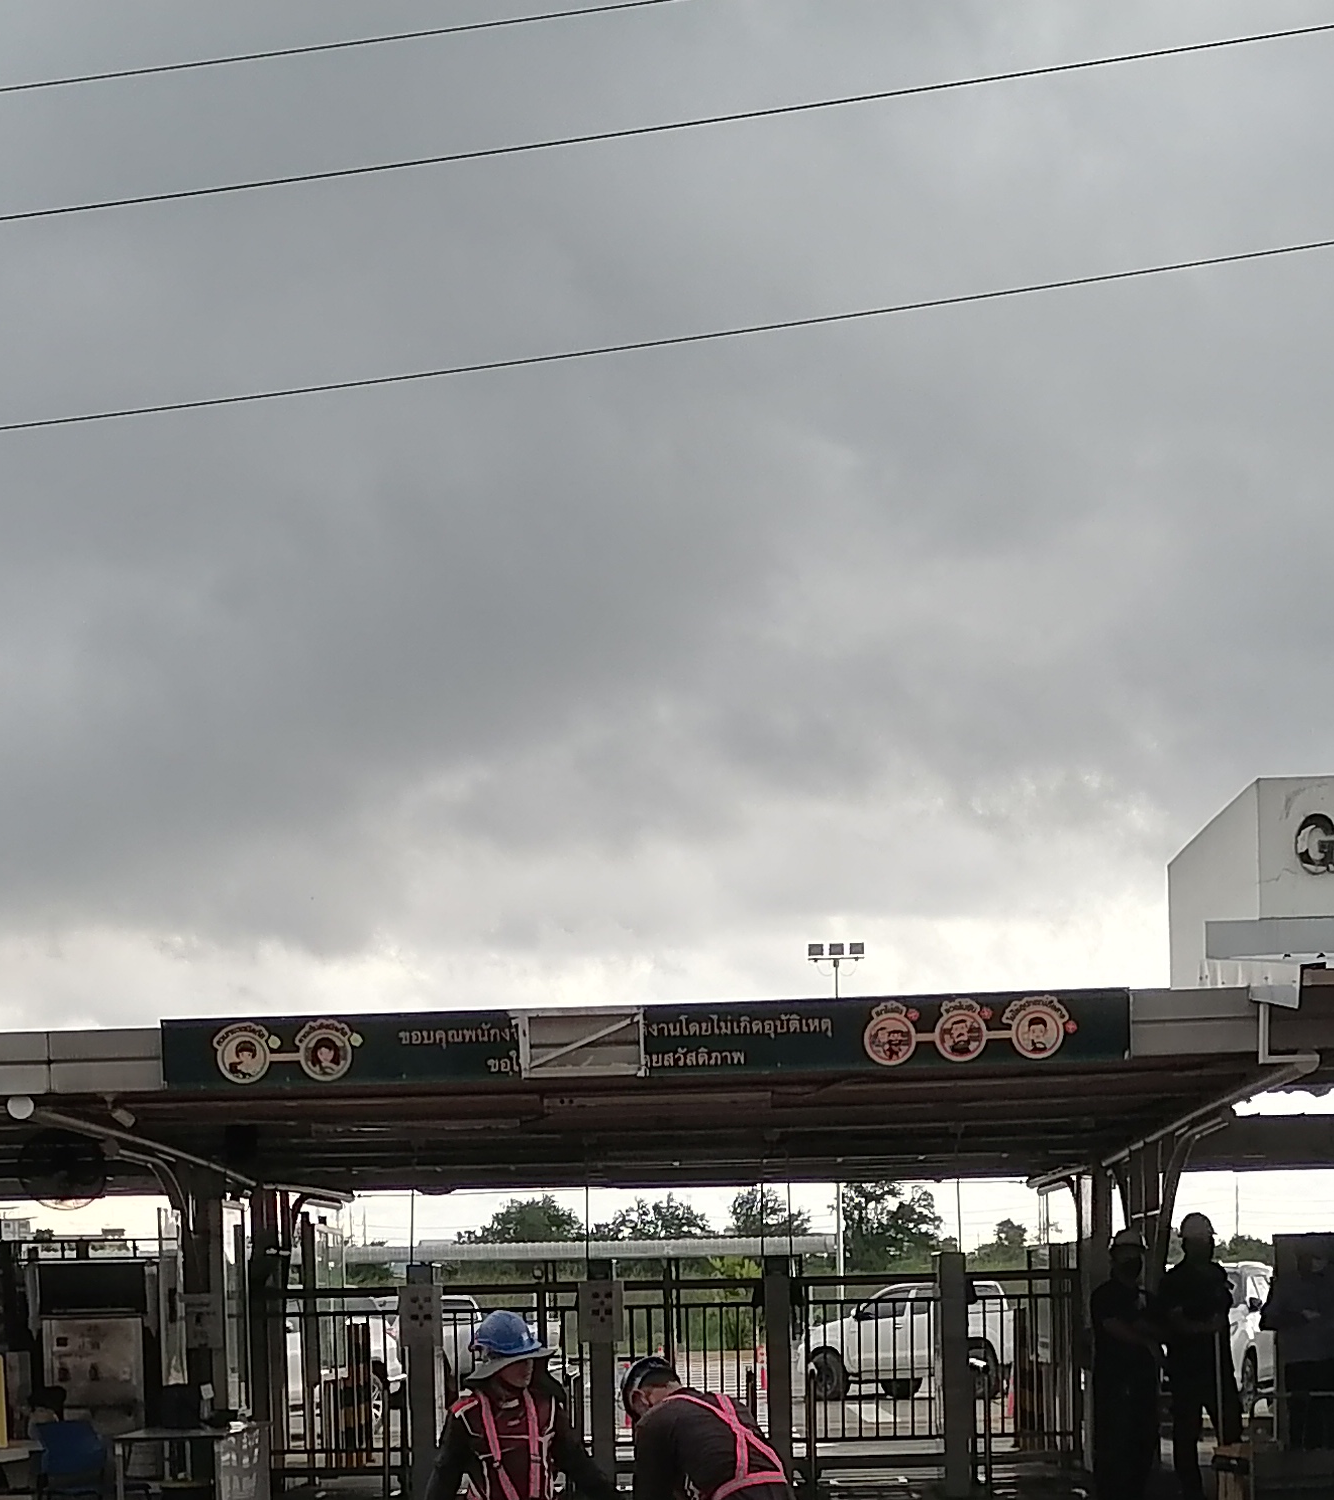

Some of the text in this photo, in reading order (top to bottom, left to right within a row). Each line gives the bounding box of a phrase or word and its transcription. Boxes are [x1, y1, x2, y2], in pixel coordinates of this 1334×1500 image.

[644, 1013, 833, 1038] งานโดยไม่เกิดอุบัติเหตุ
